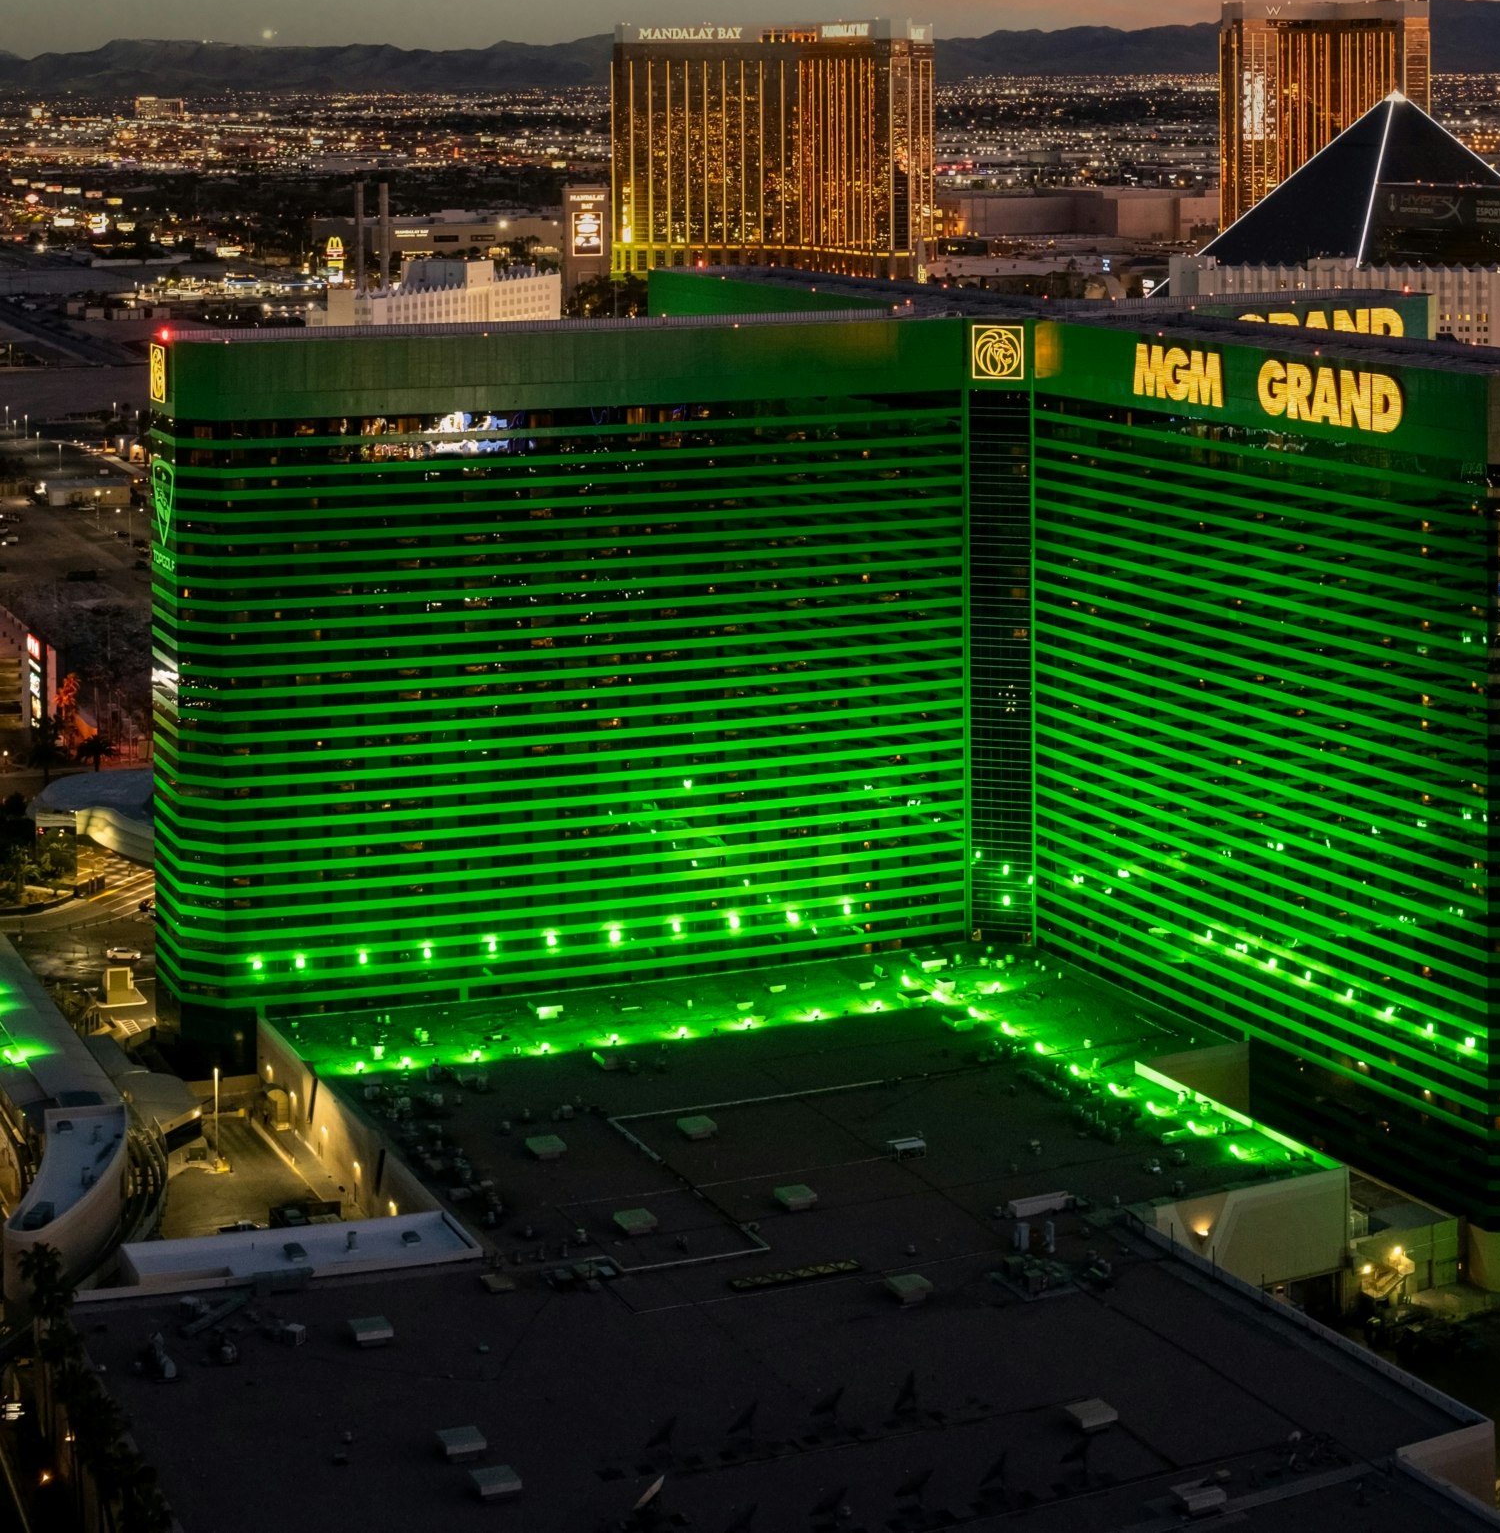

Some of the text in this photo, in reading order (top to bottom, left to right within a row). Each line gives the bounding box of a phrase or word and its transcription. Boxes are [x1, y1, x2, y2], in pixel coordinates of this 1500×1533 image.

[1266, 5, 1281, 15] W
[639, 27, 743, 40] MANDALAY BAY
[1133, 343, 1403, 433] MGM GRAND
[153, 549, 175, 573] TOPGOLF
